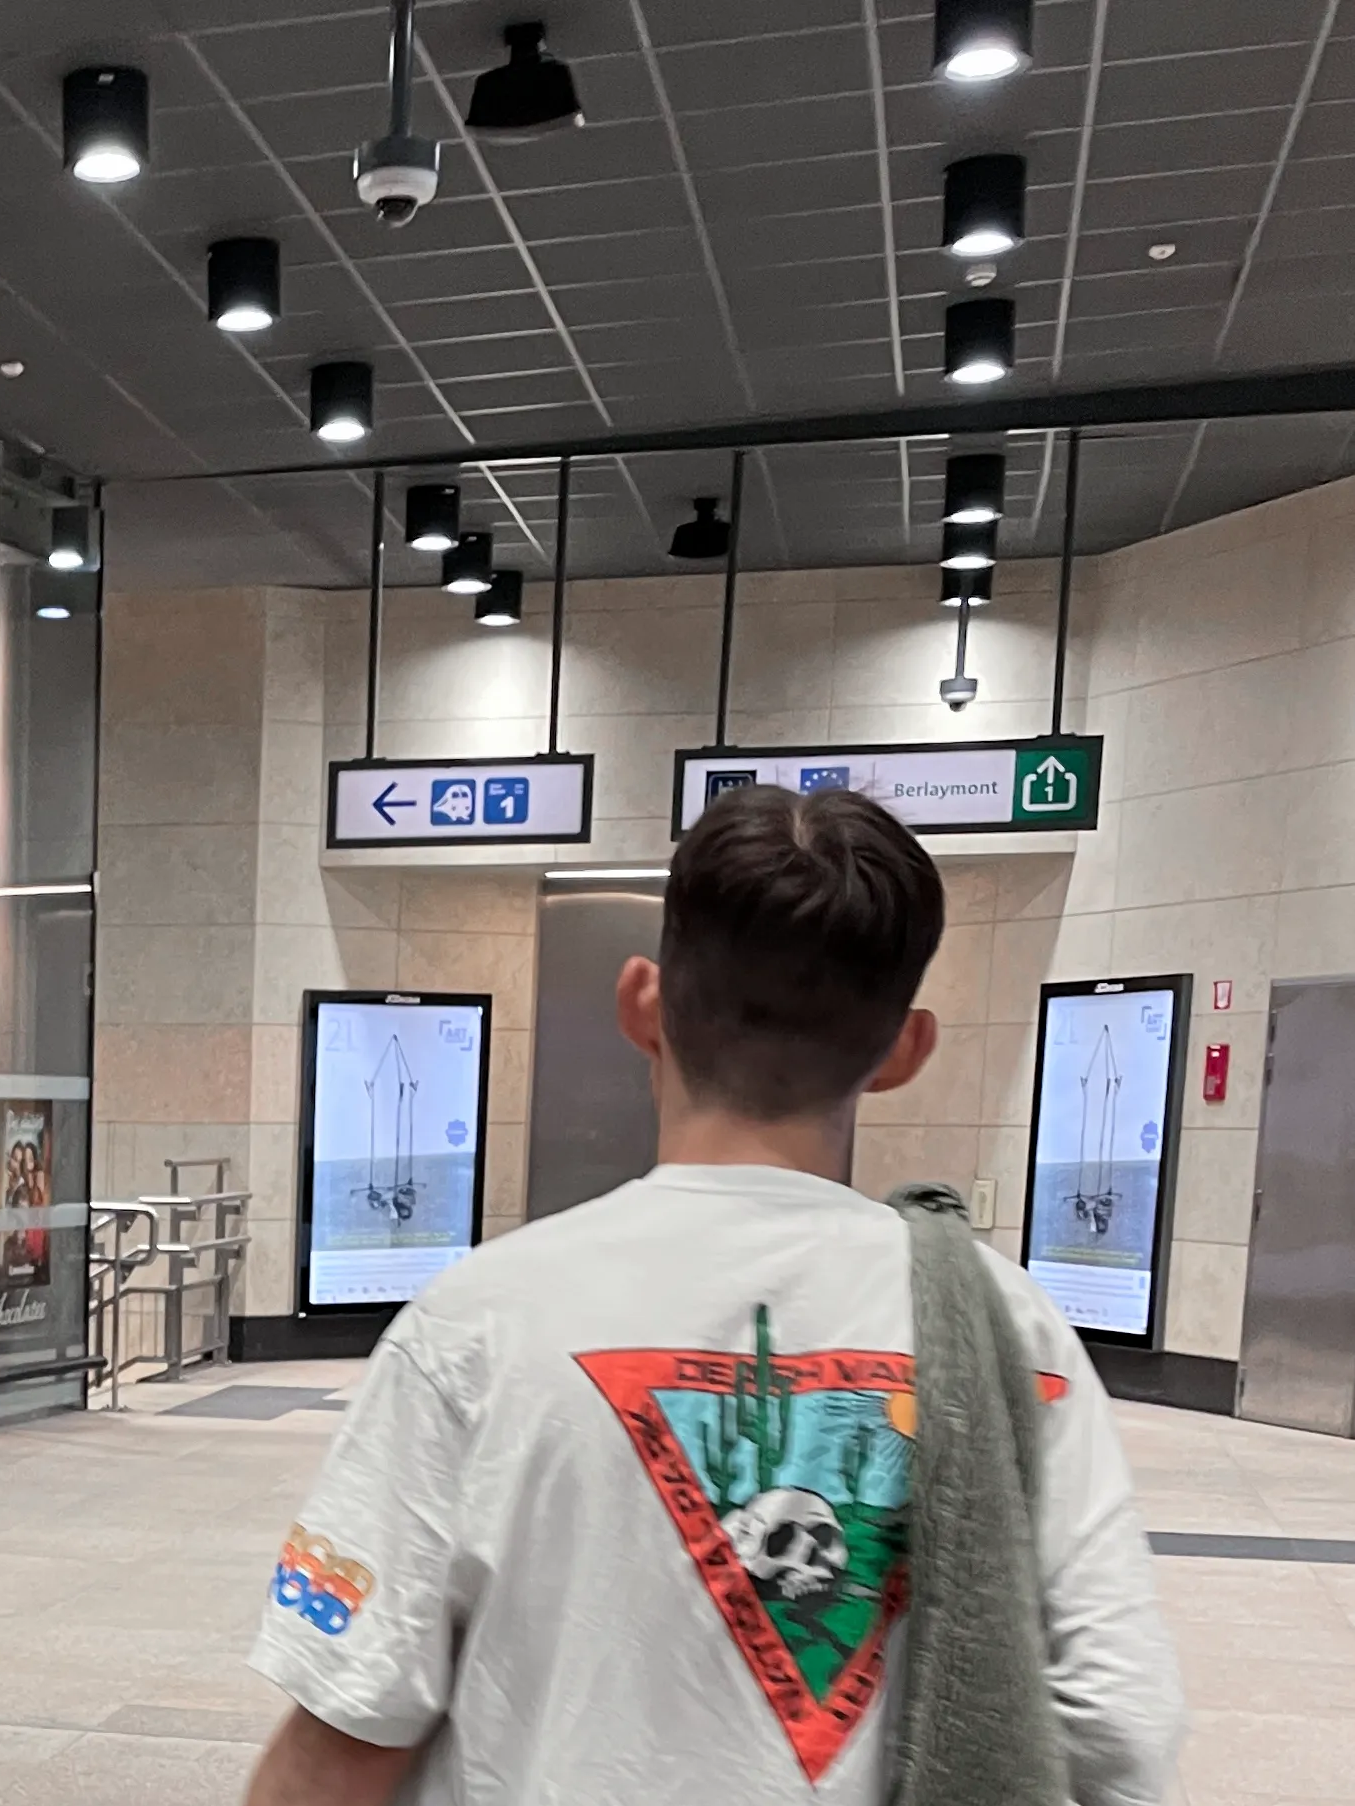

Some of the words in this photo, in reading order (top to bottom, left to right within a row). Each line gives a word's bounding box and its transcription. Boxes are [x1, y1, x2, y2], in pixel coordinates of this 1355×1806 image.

[894, 781, 998, 800] Berlaymont
[1044, 785, 1053, 802] 1
[500, 796, 514, 819] 1
